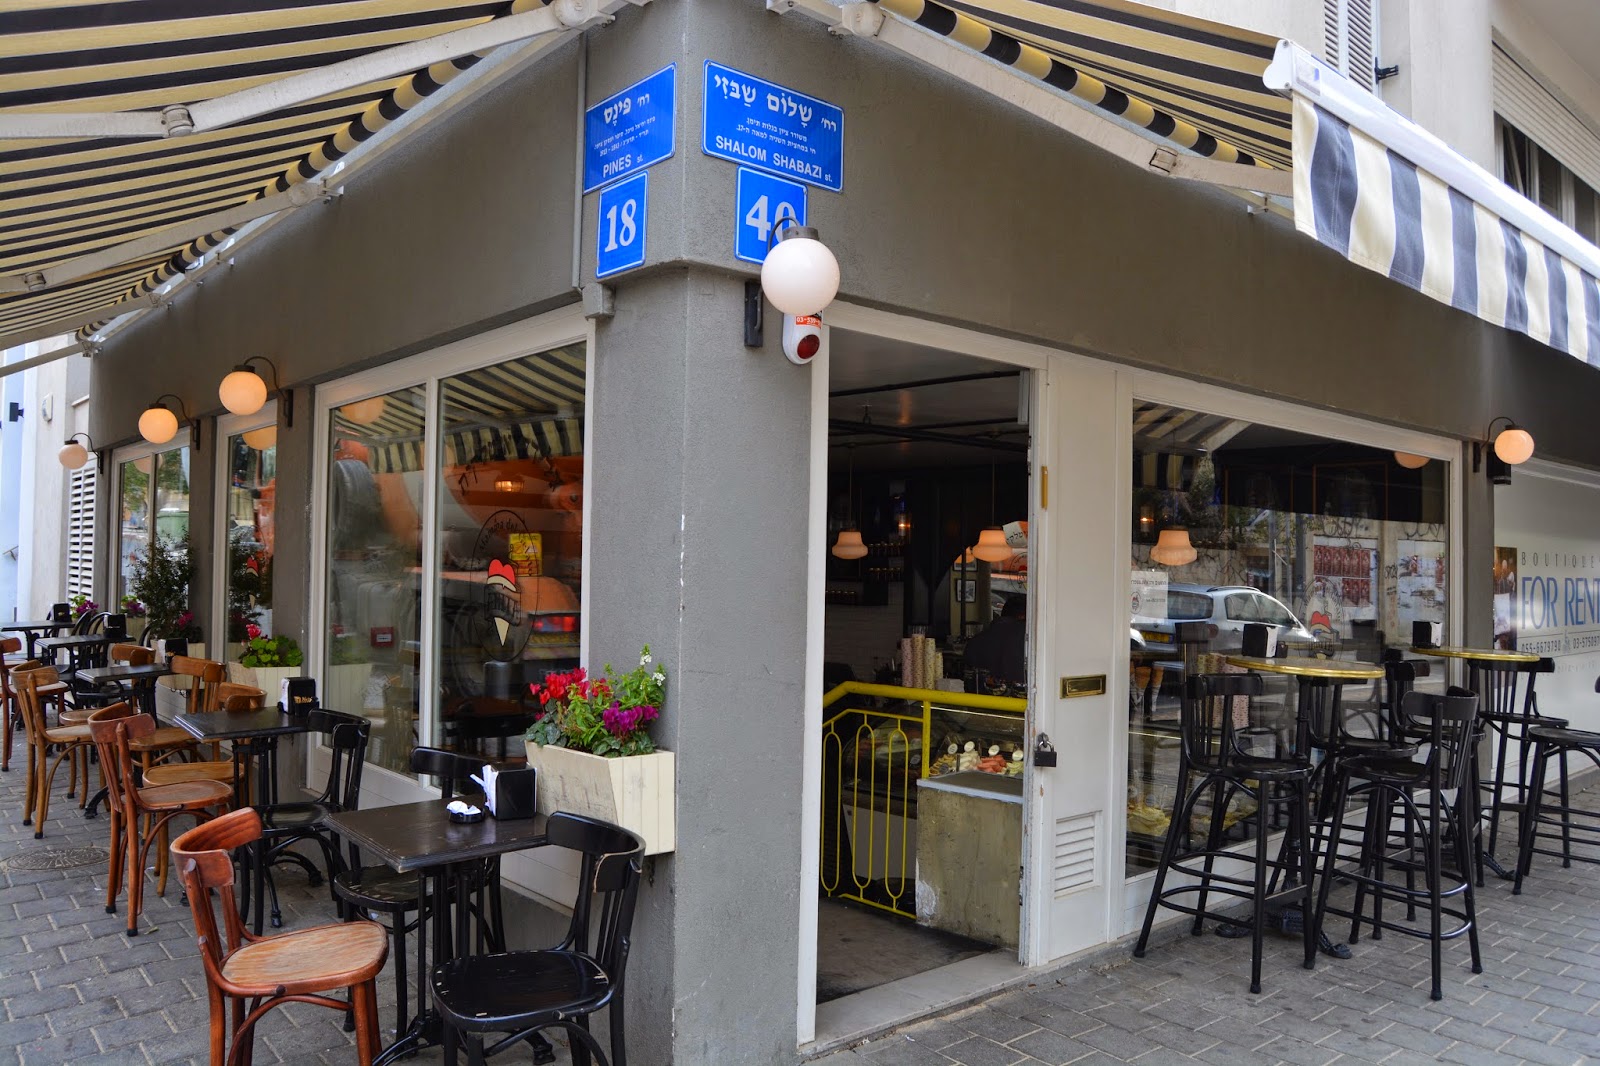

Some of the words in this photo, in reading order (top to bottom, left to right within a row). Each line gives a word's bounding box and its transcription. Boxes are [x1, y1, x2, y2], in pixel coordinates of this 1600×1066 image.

[752, 129, 767, 138] למאה
[762, 122, 777, 132] בגלות
[779, 128, 788, 136] ציון
[791, 132, 807, 142] משורר
[603, 154, 631, 178] PINES
[716, 136, 766, 161] SHALOM
[773, 153, 821, 178] SHABAZI
[604, 199, 636, 252] 18
[746, 195, 797, 244] 40
[1522, 576, 1558, 629] FOR
[1564, 577, 1600, 626] RENT
